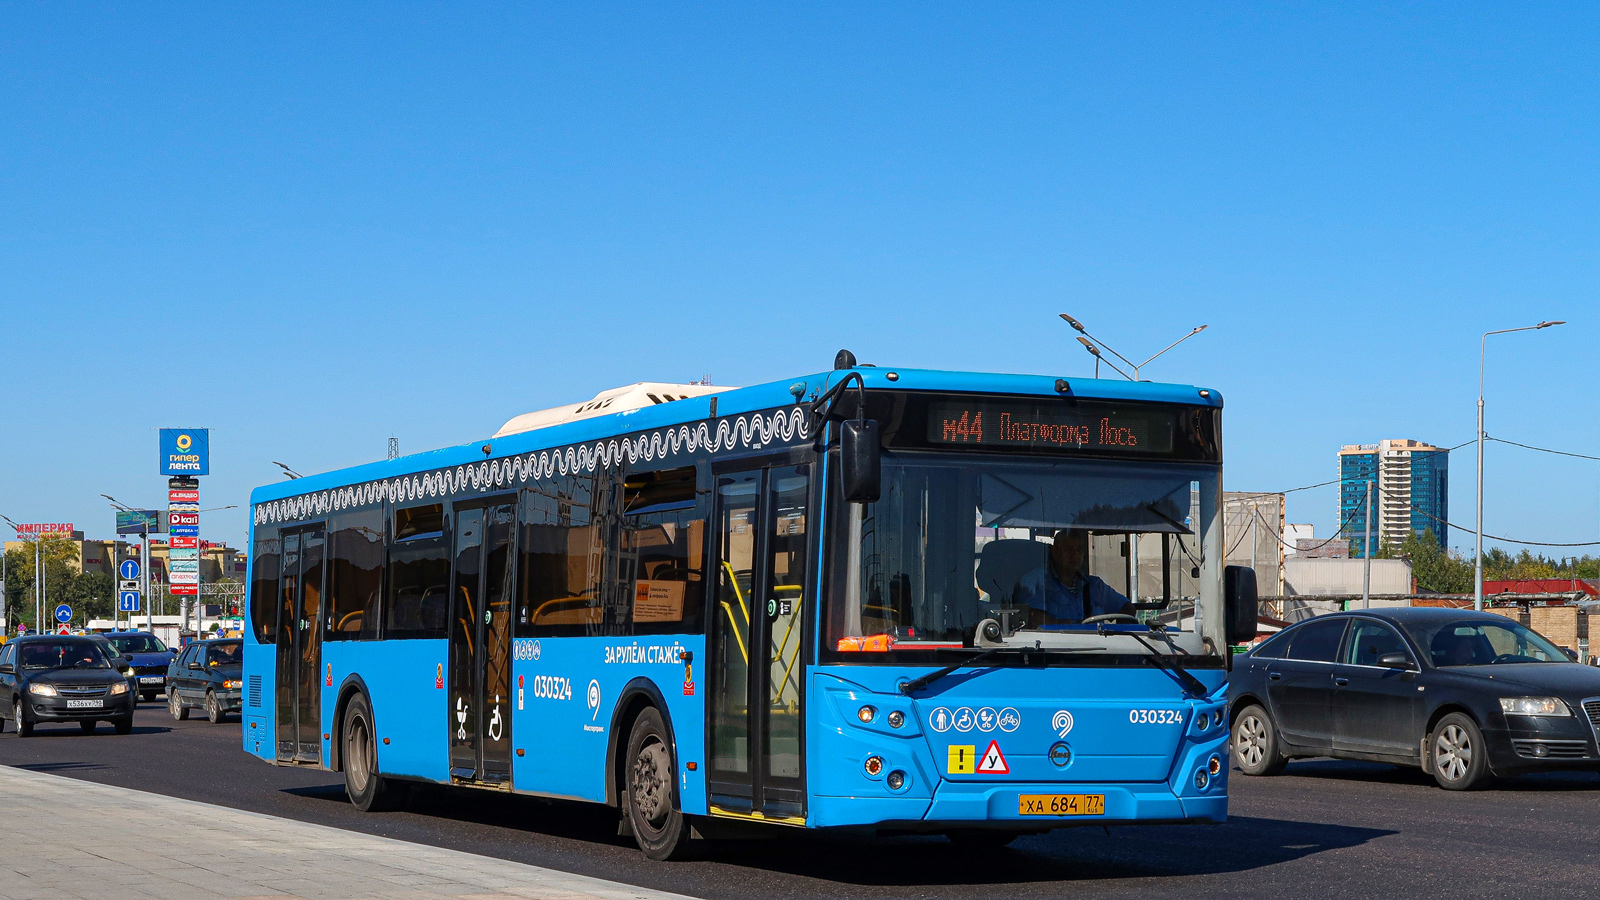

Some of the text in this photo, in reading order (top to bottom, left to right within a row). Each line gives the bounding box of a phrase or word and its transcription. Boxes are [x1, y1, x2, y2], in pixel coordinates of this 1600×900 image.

[1000, 412, 1090, 446] Платформа
[1099, 417, 1138, 446] Лось
[169, 455, 200, 463] гипер
[16, 523, 74, 533] ИМПЕРИЯ
[604, 646, 616, 664] ЗА
[616, 641, 647, 664] РУЛЁМ
[534, 675, 572, 701] 030324
[1129, 709, 1183, 725] 030324
[1050, 797, 1078, 813] 684
[1086, 796, 1100, 808] 77
